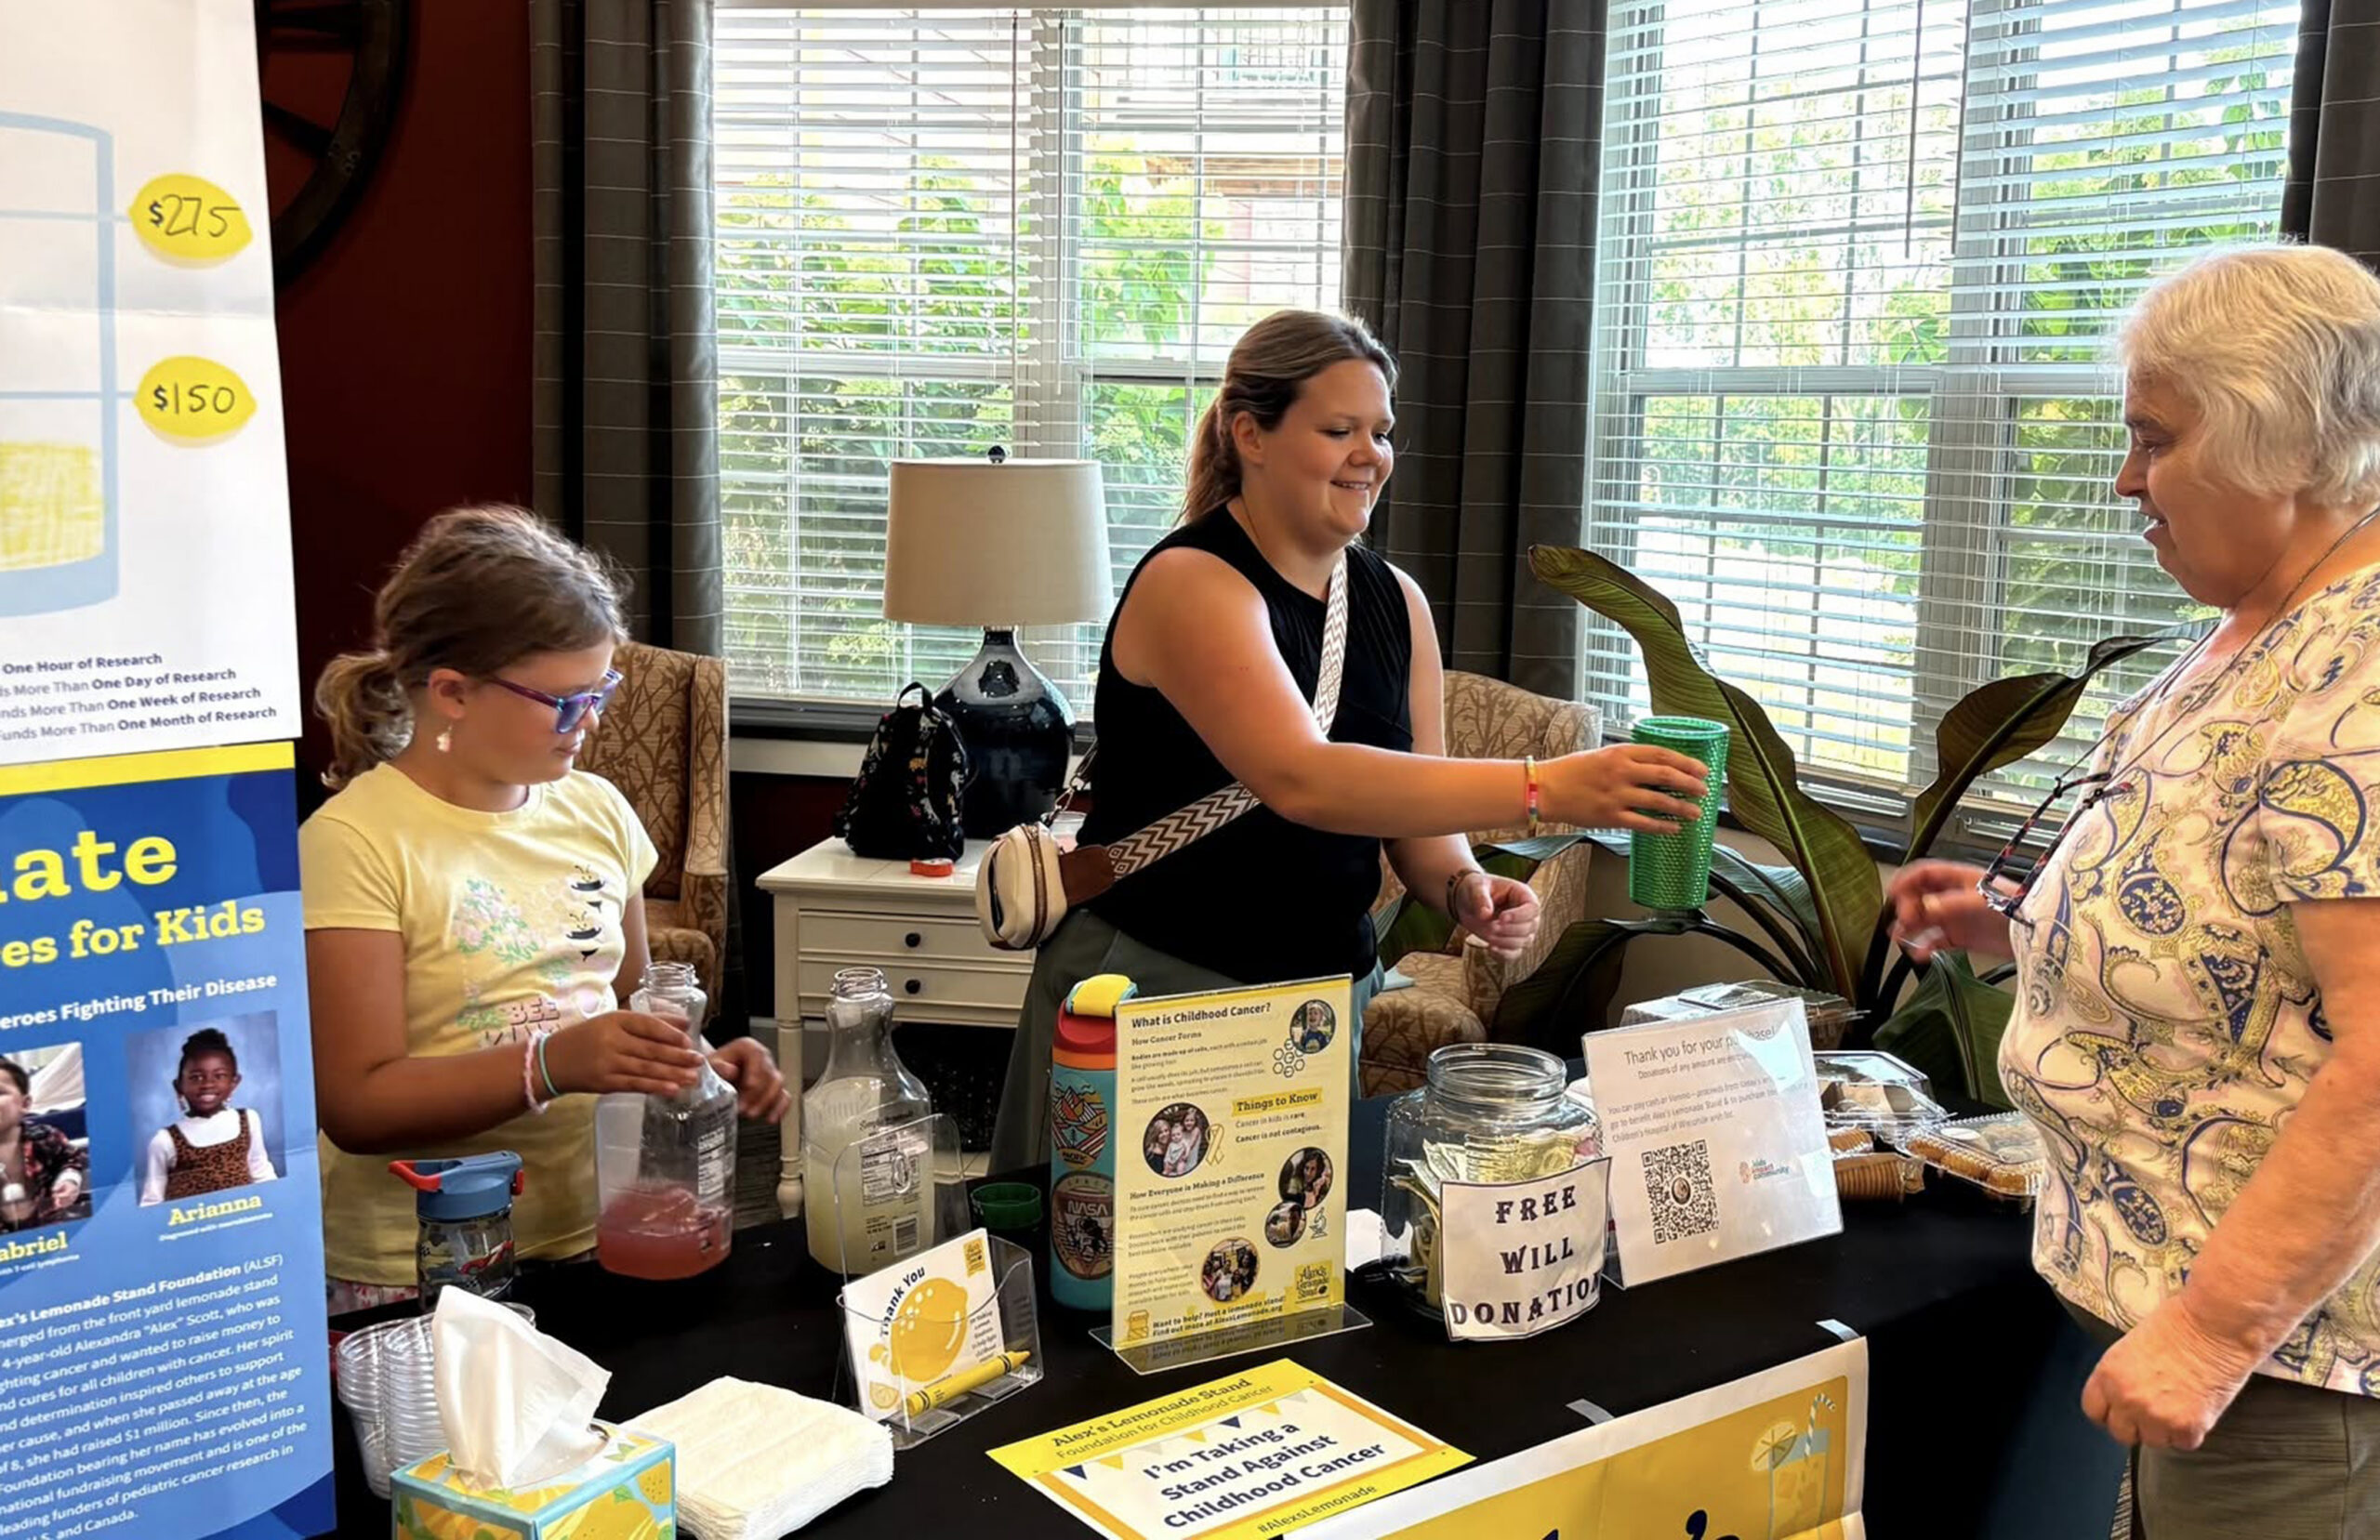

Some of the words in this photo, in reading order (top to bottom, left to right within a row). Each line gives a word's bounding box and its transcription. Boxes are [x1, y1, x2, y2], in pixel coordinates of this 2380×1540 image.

[150, 194, 242, 238] $275
[154, 382, 235, 415] $150
[3, 664, 33, 674] One
[37, 662, 73, 671] Hour
[77, 658, 93, 669] of
[96, 653, 163, 667] Research
[12, 685, 50, 696] More
[53, 681, 89, 691] Than
[91, 678, 122, 690] One
[124, 676, 152, 689] Day
[154, 673, 170, 685] of
[173, 668, 237, 683] Research
[30, 705, 66, 716] More
[69, 702, 105, 712] Than
[106, 699, 138, 710] One
[139, 694, 178, 707] Week
[180, 691, 196, 704] of
[198, 688, 261, 702] Research
[40, 726, 77, 736] More
[80, 722, 115, 733] Than
[117, 719, 147, 731] One
[150, 714, 195, 728] Month
[197, 711, 213, 723] of
[215, 706, 277, 721] Research
[0, 831, 178, 902] ate
[69, 919, 144, 959] for
[154, 900, 265, 946] Kids
[61, 996, 146, 1020] Fighting
[150, 985, 201, 1004] Their
[206, 977, 276, 995] Disease
[1131, 1017, 1160, 1028] What
[1162, 1015, 1171, 1024] is
[1174, 1008, 1227, 1023] Childhood
[1230, 1003, 1271, 1016] Cancer?
[1624, 1046, 1659, 1066] Thank
[1660, 1047, 1680, 1061] you
[1682, 1041, 1697, 1055] for
[1699, 1038, 1724, 1054] your
[1236, 1099, 1274, 1112] Things
[1289, 1093, 1317, 1104] Know
[1236, 1133, 1260, 1143] Cancer
[167, 1195, 262, 1226] Arianna
[1067, 1200, 1108, 1217] NASA
[1148, 1186, 1183, 1197] Everyone
[1193, 1179, 1220, 1190] Making
[1227, 1172, 1264, 1184] Difference
[1496, 1186, 1576, 1224] FREE
[1500, 1237, 1574, 1273] WILL
[31, 1296, 110, 1321] Lemonade
[113, 1283, 156, 1302] Stand
[159, 1267, 241, 1291] Foundation
[245, 1256, 283, 1272] (ALSF)
[47, 1323, 81, 1337] from
[83, 1318, 106, 1329] the
[108, 1309, 141, 1323] front
[144, 1299, 174, 1318] yard
[176, 1286, 241, 1308] lemonade
[244, 1274, 278, 1292] stand
[879, 1286, 905, 1336] Thank
[903, 1267, 925, 1287] You
[2, 1344, 73, 1368] 4-year-old
[75, 1330, 141, 1351] Alexandra
[144, 1317, 184, 1334] "Alex"
[187, 1310, 224, 1325] Scott,
[226, 1303, 254, 1315] who
[256, 1296, 281, 1308] was
[43, 1362, 89, 1380] cancer
[91, 1353, 117, 1369] and
[120, 1341, 169, 1362] wanted
[171, 1339, 187, 1349] to
[189, 1331, 219, 1345] raise
[221, 1320, 265, 1336] money
[267, 1315, 281, 1324] to
[19, 1391, 57, 1406] cures
[58, 1385, 78, 1397] for
[81, 1378, 98, 1392] all
[99, 1367, 155, 1387] children
[157, 1358, 187, 1372] with
[189, 1347, 233, 1364] cancer.
[237, 1340, 259, 1351] Her
[261, 1330, 294, 1347] spirit
[20, 1397, 117, 1427] determination
[120, 1380, 173, 1402] inspired
[175, 1371, 217, 1388] others
[218, 1367, 232, 1376] to
[235, 1352, 284, 1373] support
[10, 1460, 24, 1470] 8,
[26, 1454, 50, 1467] she
[53, 1444, 79, 1459] had
[82, 1433, 123, 1452] raised
[125, 1429, 140, 1441] $1
[143, 1417, 192, 1435] million.
[195, 1406, 230, 1422] Since
[231, 1398, 265, 1412] then,
[267, 1390, 287, 1402] the
[18, 1432, 62, 1448] cause,
[64, 1421, 91, 1437] and
[93, 1414, 130, 1428] when
[132, 1407, 156, 1419] she
[158, 1392, 204, 1415] passed
[206, 1385, 239, 1400] away
[242, 1379, 255, 1390] at
[257, 1375, 278, 1386] the
[280, 1367, 301, 1380] age
[1051, 1422, 1106, 1447] Alex's
[1107, 1397, 1196, 1428] Lemonade
[1198, 1378, 1253, 1400] Stand
[1056, 1429, 1139, 1459] Foundation
[1139, 1422, 1158, 1433] for
[1159, 1399, 1228, 1426] Childhood
[1228, 1385, 1273, 1403] Cancer
[57, 1472, 132, 1498] fundraising
[134, 1452, 204, 1477] movement
[205, 1442, 231, 1458] and
[233, 1441, 244, 1450] is
[245, 1434, 270, 1446] one
[271, 1427, 284, 1439] of
[286, 1423, 307, 1434] the
[77, 1454, 128, 1474] bearing
[130, 1447, 152, 1459] her
[154, 1436, 192, 1452] name
[193, 1429, 217, 1441] has
[218, 1413, 268, 1435] evolved
[270, 1408, 295, 1420] into
[297, 1404, 305, 1413] a
[1143, 1458, 1194, 1480] I'm
[1190, 1428, 1286, 1462] Taking
[1280, 1423, 1300, 1434] a
[1160, 1466, 1243, 1501] Stand
[1242, 1434, 1338, 1473] Against
[52, 1500, 103, 1520] funders
[105, 1493, 119, 1506] of
[122, 1479, 179, 1503] pediatric
[181, 1466, 224, 1483] cancer
[227, 1449, 279, 1470] research
[282, 1446, 294, 1454] in
[1163, 1473, 1301, 1529] Childhood
[1301, 1442, 1386, 1479] Cancer
[1257, 1484, 1378, 1533] #AlexsLemonade
